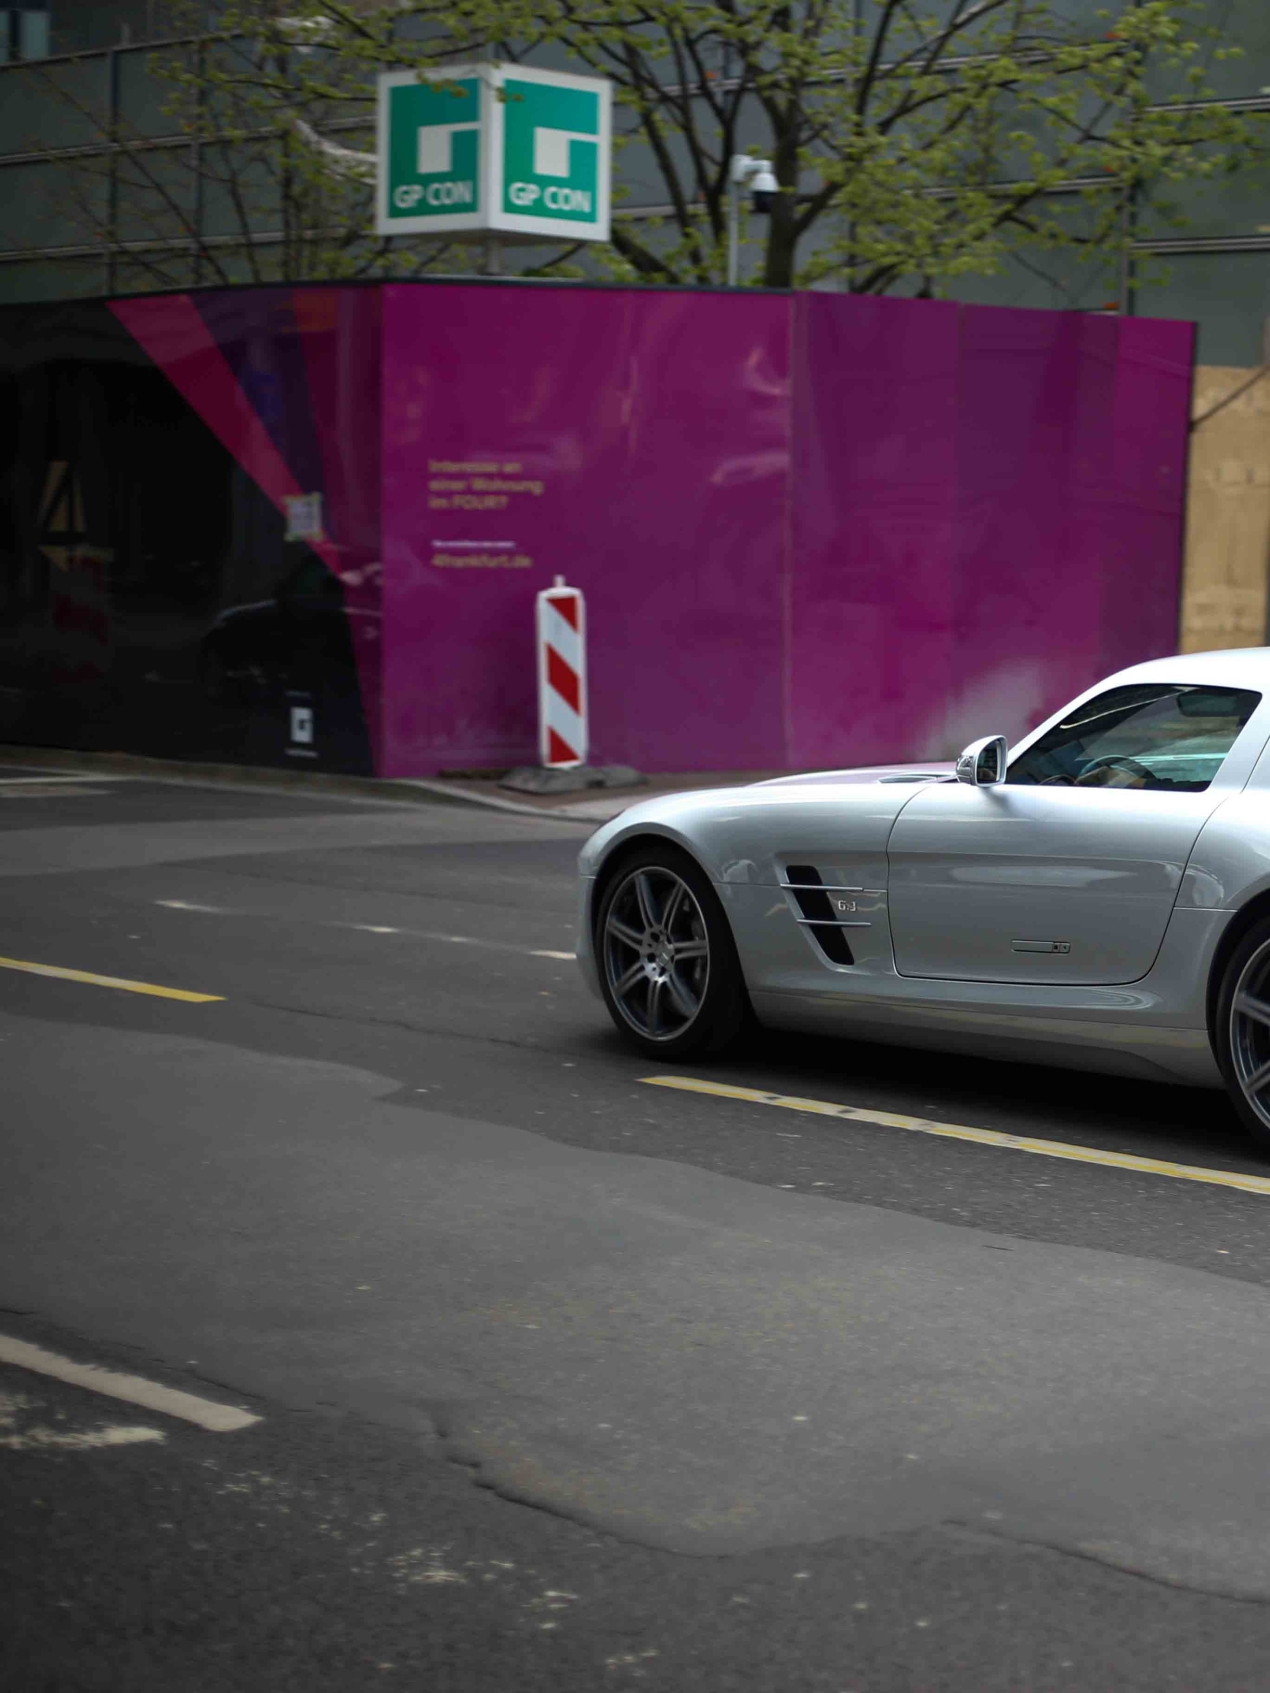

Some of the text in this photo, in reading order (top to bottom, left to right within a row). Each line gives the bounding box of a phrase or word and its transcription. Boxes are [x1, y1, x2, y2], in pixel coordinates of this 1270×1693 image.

[393, 181, 473, 208] GP CON
[508, 182, 591, 213] GP CON
[838, 900, 856, 912] 6.3
